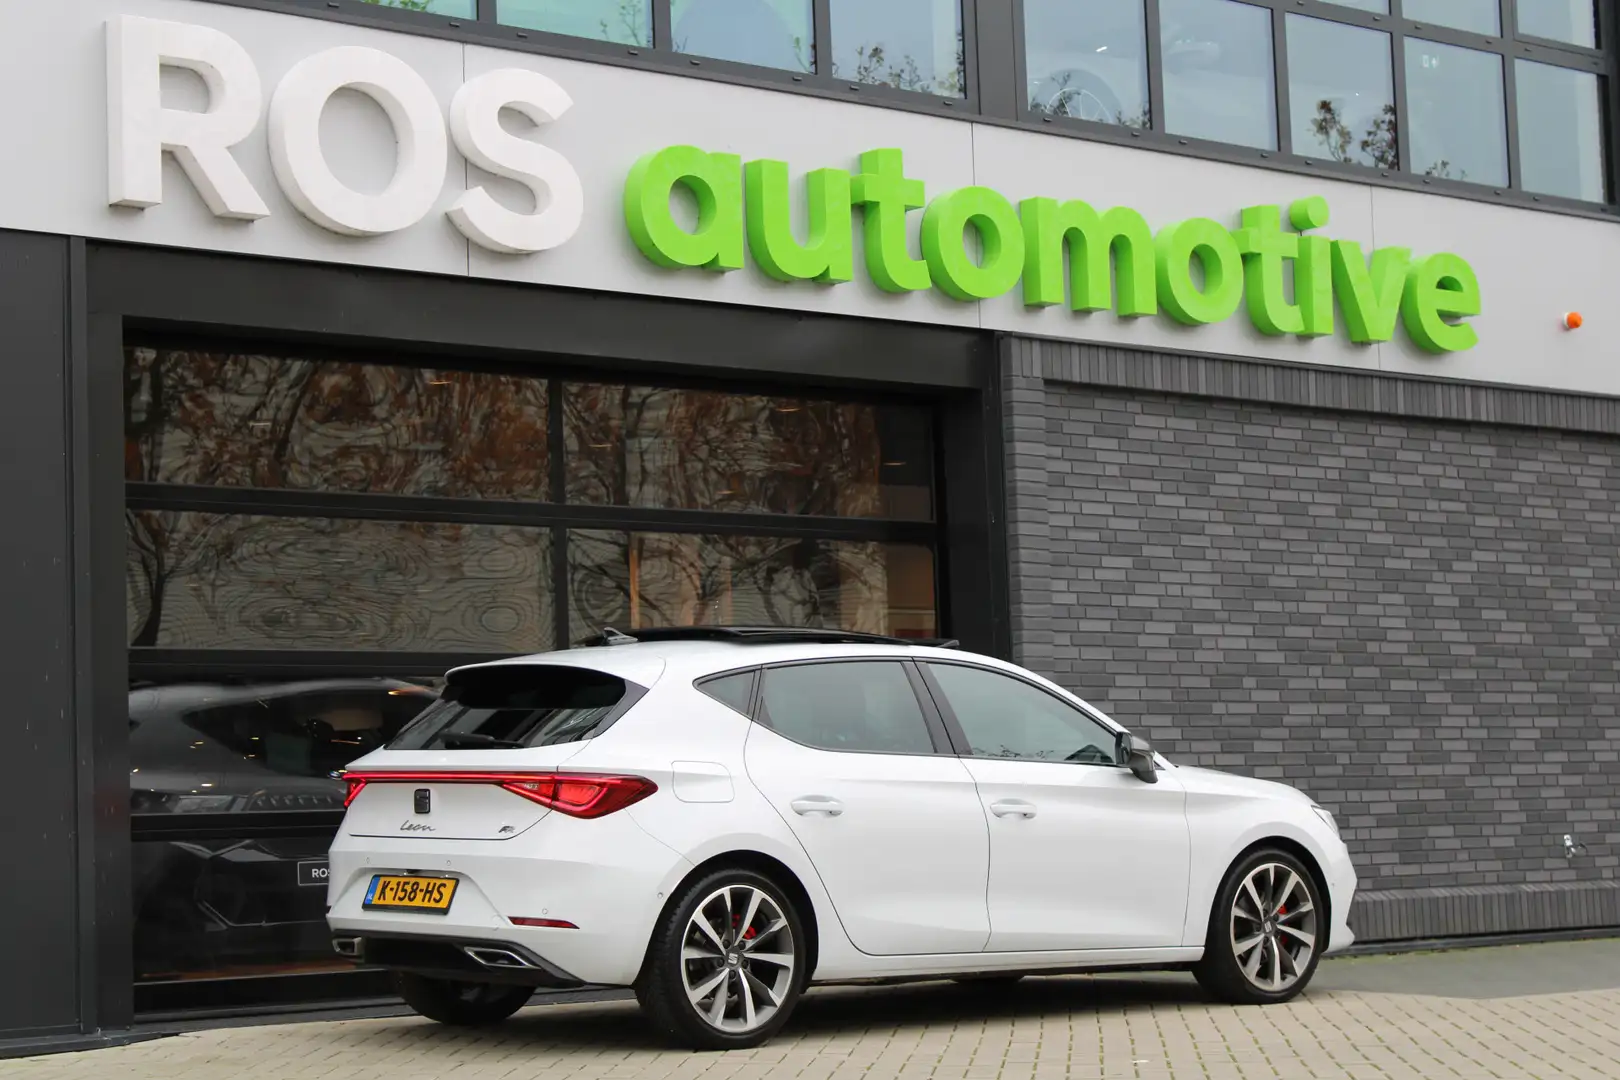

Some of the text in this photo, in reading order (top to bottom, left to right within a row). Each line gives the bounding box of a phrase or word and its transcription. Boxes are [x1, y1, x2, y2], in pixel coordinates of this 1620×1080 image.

[105, 14, 1482, 355] ROS automotive
[400, 820, 436, 832] Leon
[311, 868, 330, 878] RO
[377, 880, 447, 904] K-158-HS
